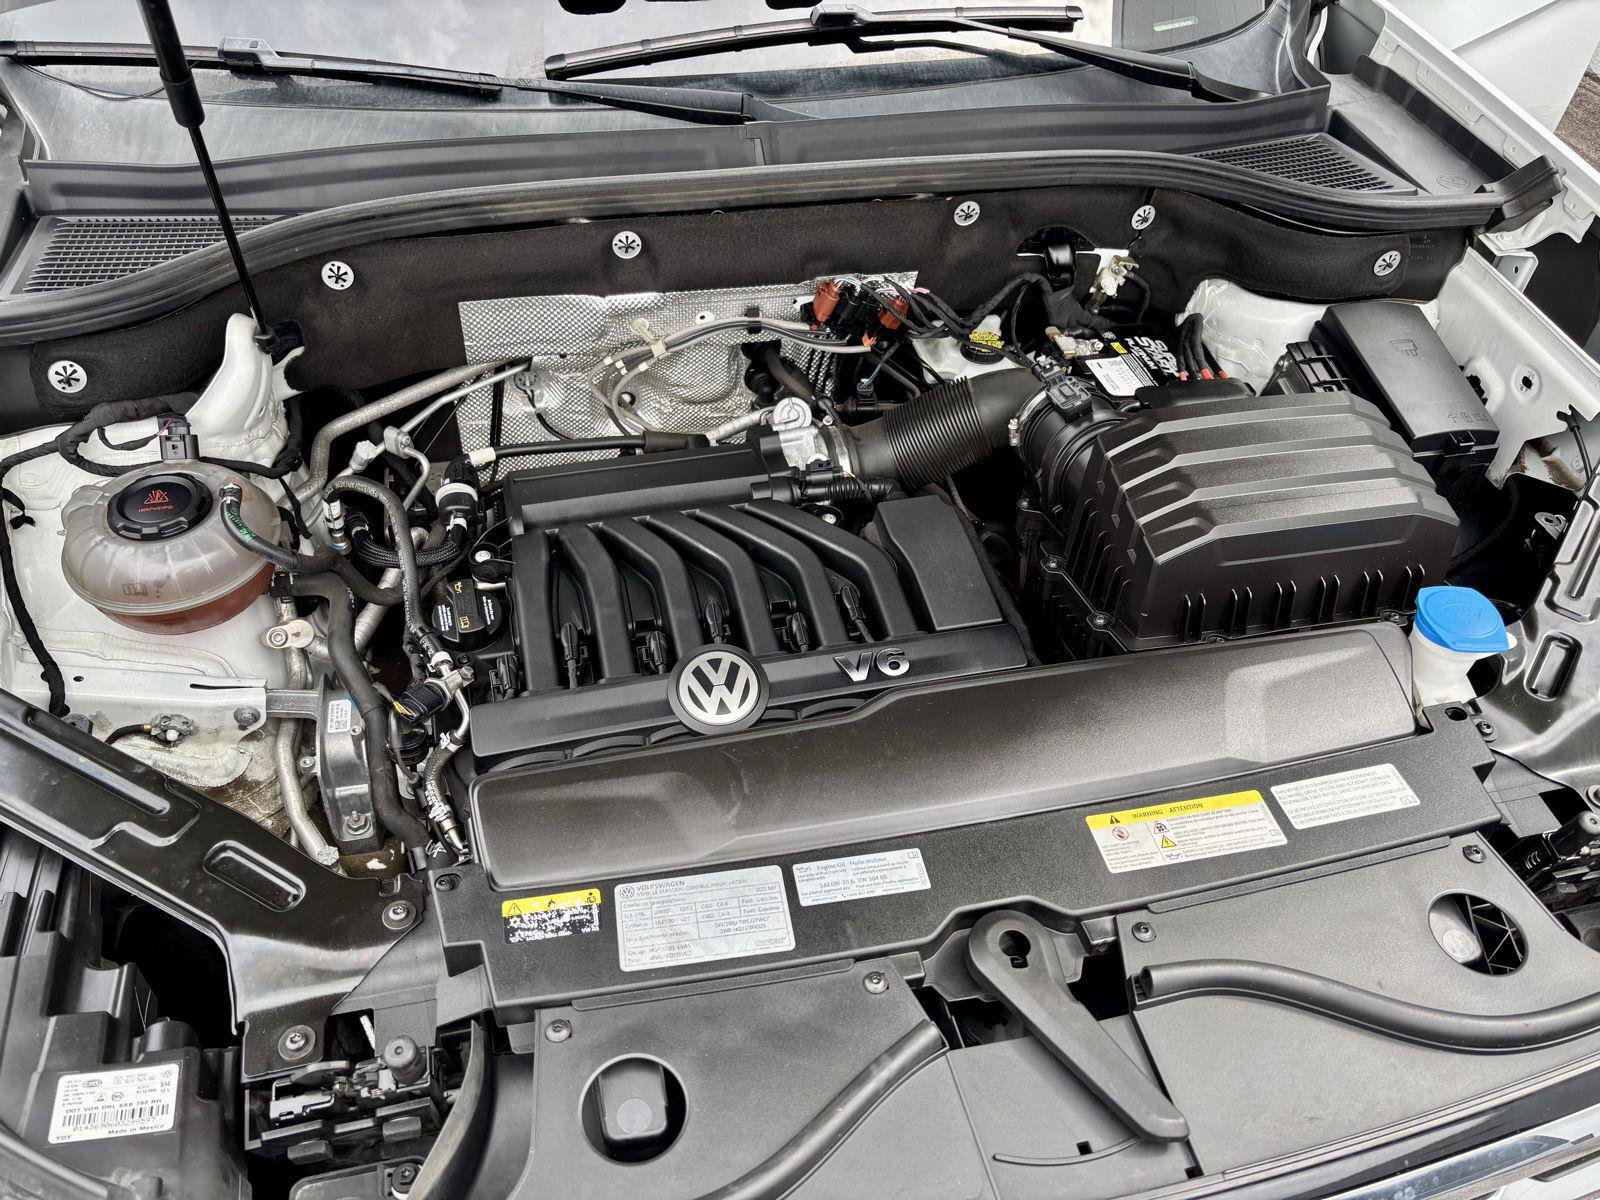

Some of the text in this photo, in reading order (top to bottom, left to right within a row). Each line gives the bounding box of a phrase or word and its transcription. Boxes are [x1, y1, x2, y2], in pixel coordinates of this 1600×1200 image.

[832, 647, 910, 682] V6
[679, 651, 759, 726] VW
[1132, 808, 1163, 819] WARNING
[1169, 802, 1203, 813] ATTENTION
[637, 880, 685, 891] VOLKSWAGEN
